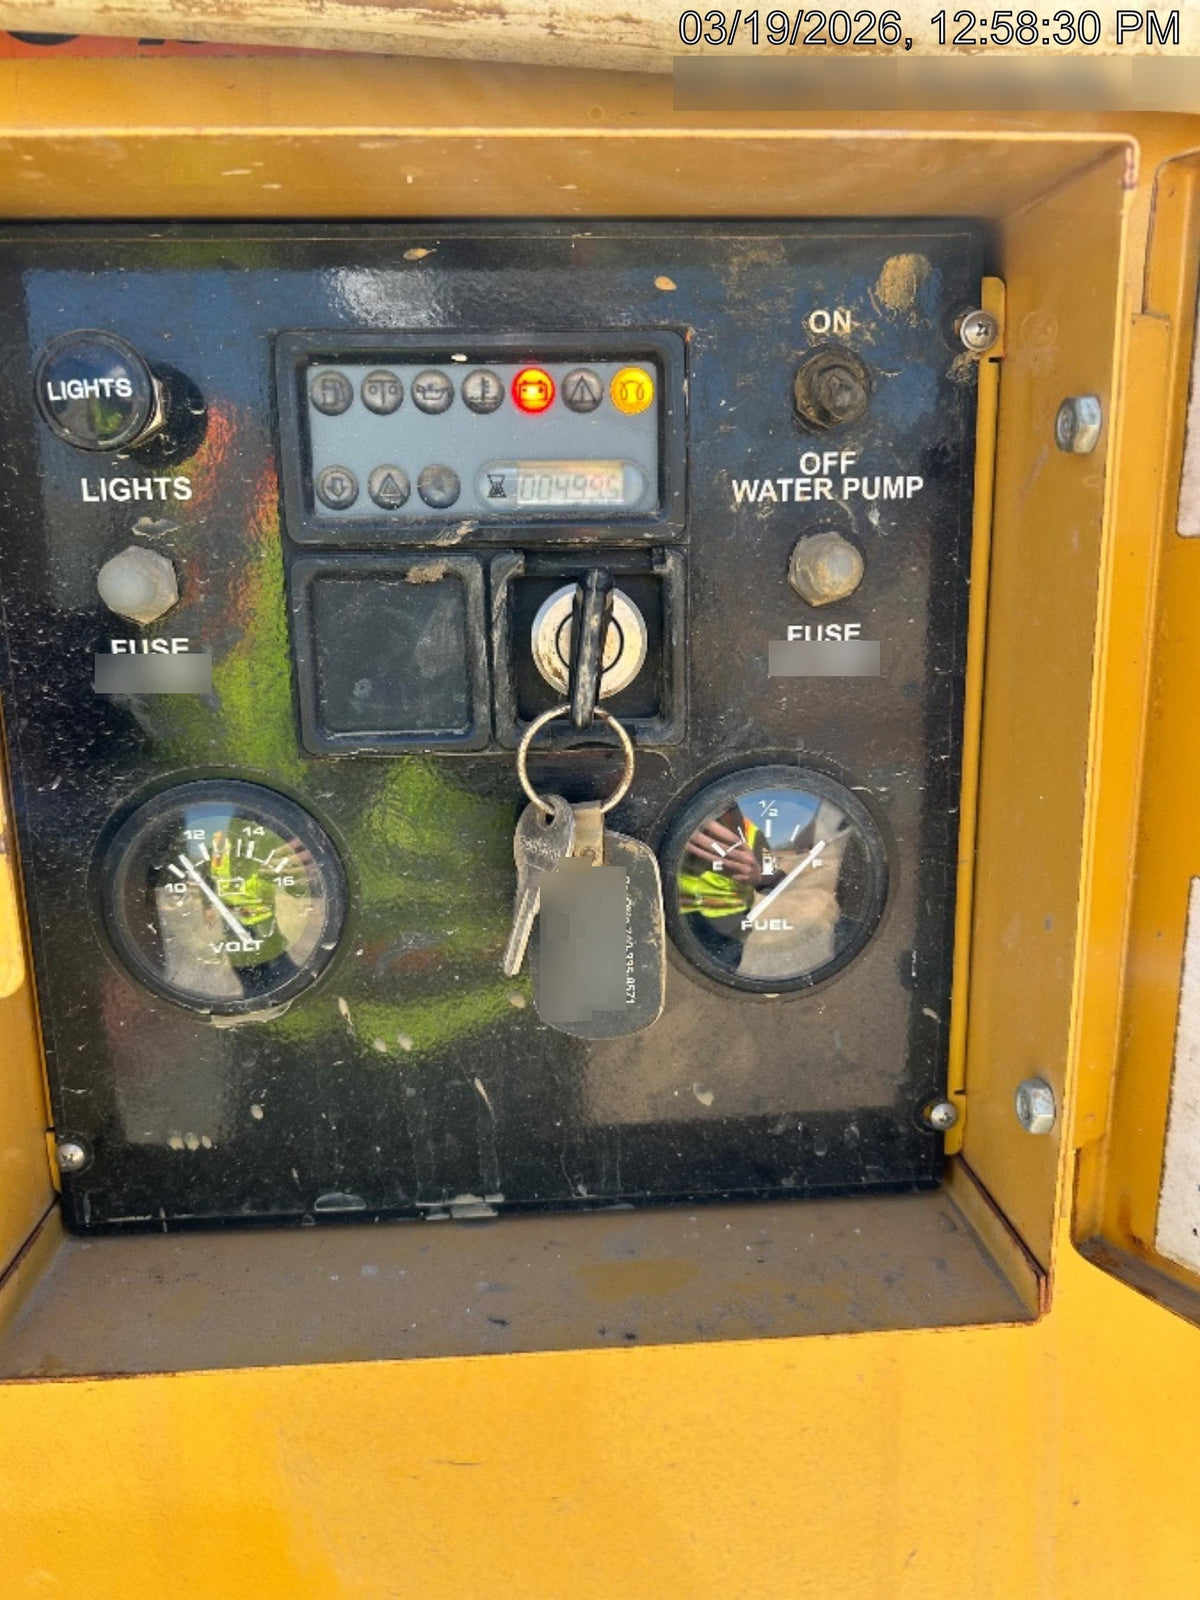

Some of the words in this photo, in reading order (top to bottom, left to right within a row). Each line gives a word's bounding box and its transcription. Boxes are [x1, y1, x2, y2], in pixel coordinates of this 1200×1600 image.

[808, 310, 852, 334] ON
[47, 377, 133, 401] LIGHTS
[800, 451, 856, 475] OFF
[81, 477, 192, 502] LIGHTS
[732, 478, 833, 503] WATER
[843, 476, 924, 500] PUMP
[183, 829, 206, 841] 12
[242, 826, 266, 836] 14
[712, 860, 723, 870] E
[812, 859, 823, 869] F
[164, 882, 187, 894] 10
[272, 876, 295, 887] 16
[741, 918, 794, 931] FUEL
[209, 939, 264, 954] VOLT
